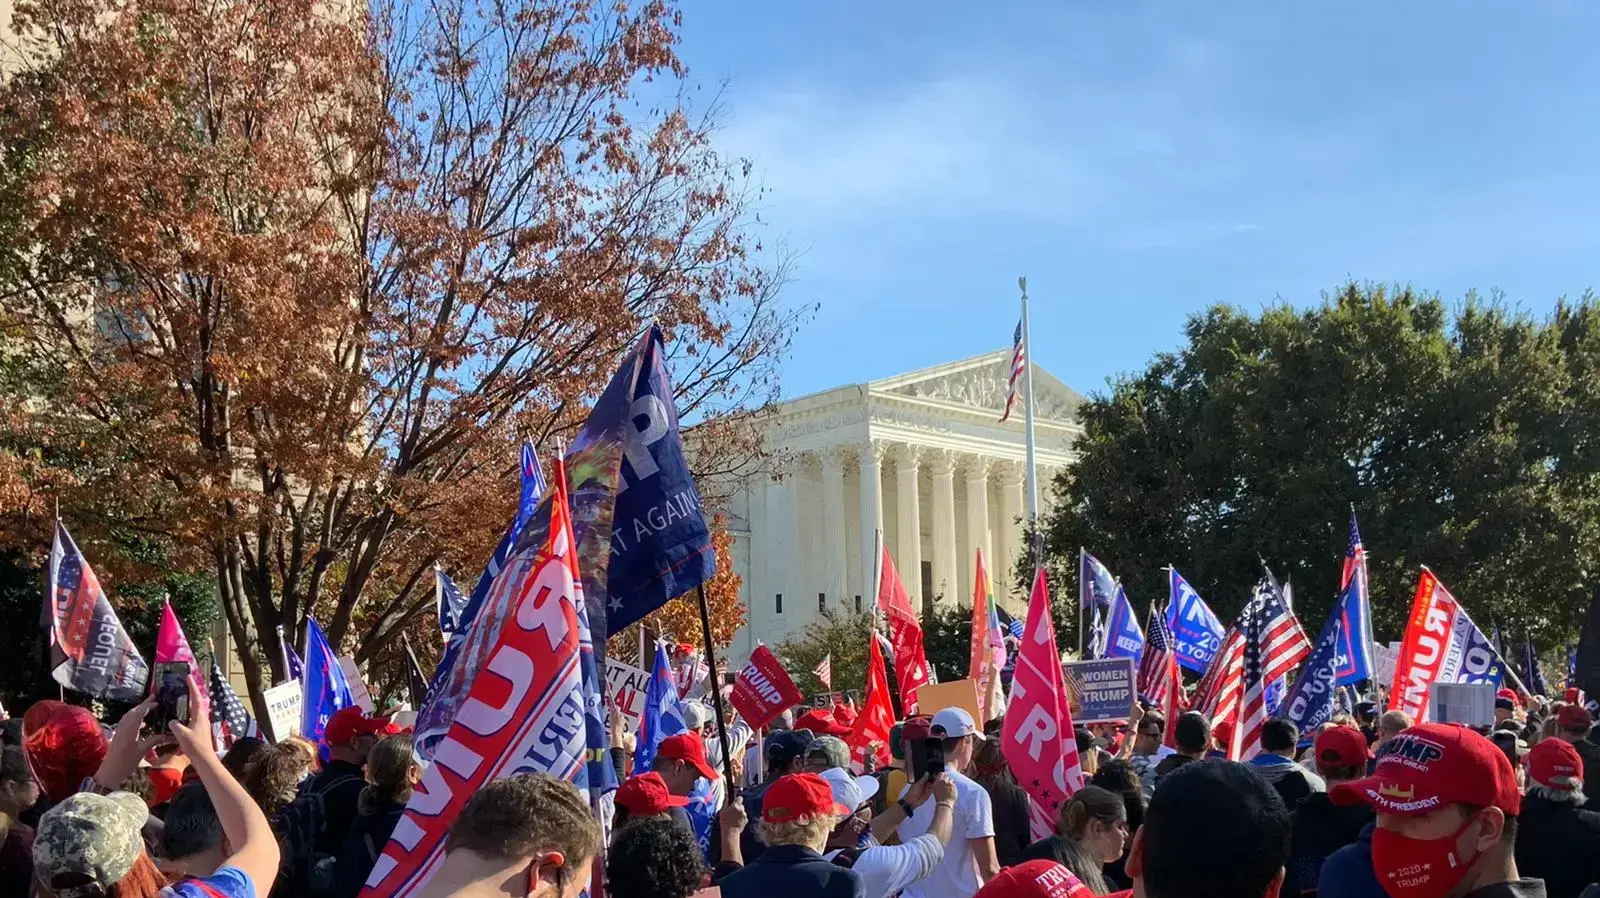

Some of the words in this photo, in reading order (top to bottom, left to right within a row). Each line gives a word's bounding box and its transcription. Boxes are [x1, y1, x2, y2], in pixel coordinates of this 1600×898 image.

[1116, 635, 1142, 653] KEEP
[1081, 669, 1128, 682] WOMEN
[1081, 689, 1130, 703] TRUMP
[270, 694, 301, 713] TRUMP
[1389, 795, 1441, 811] PRESIDENT
[1397, 864, 1421, 877] 2020
[1396, 874, 1430, 888] TRUMP
